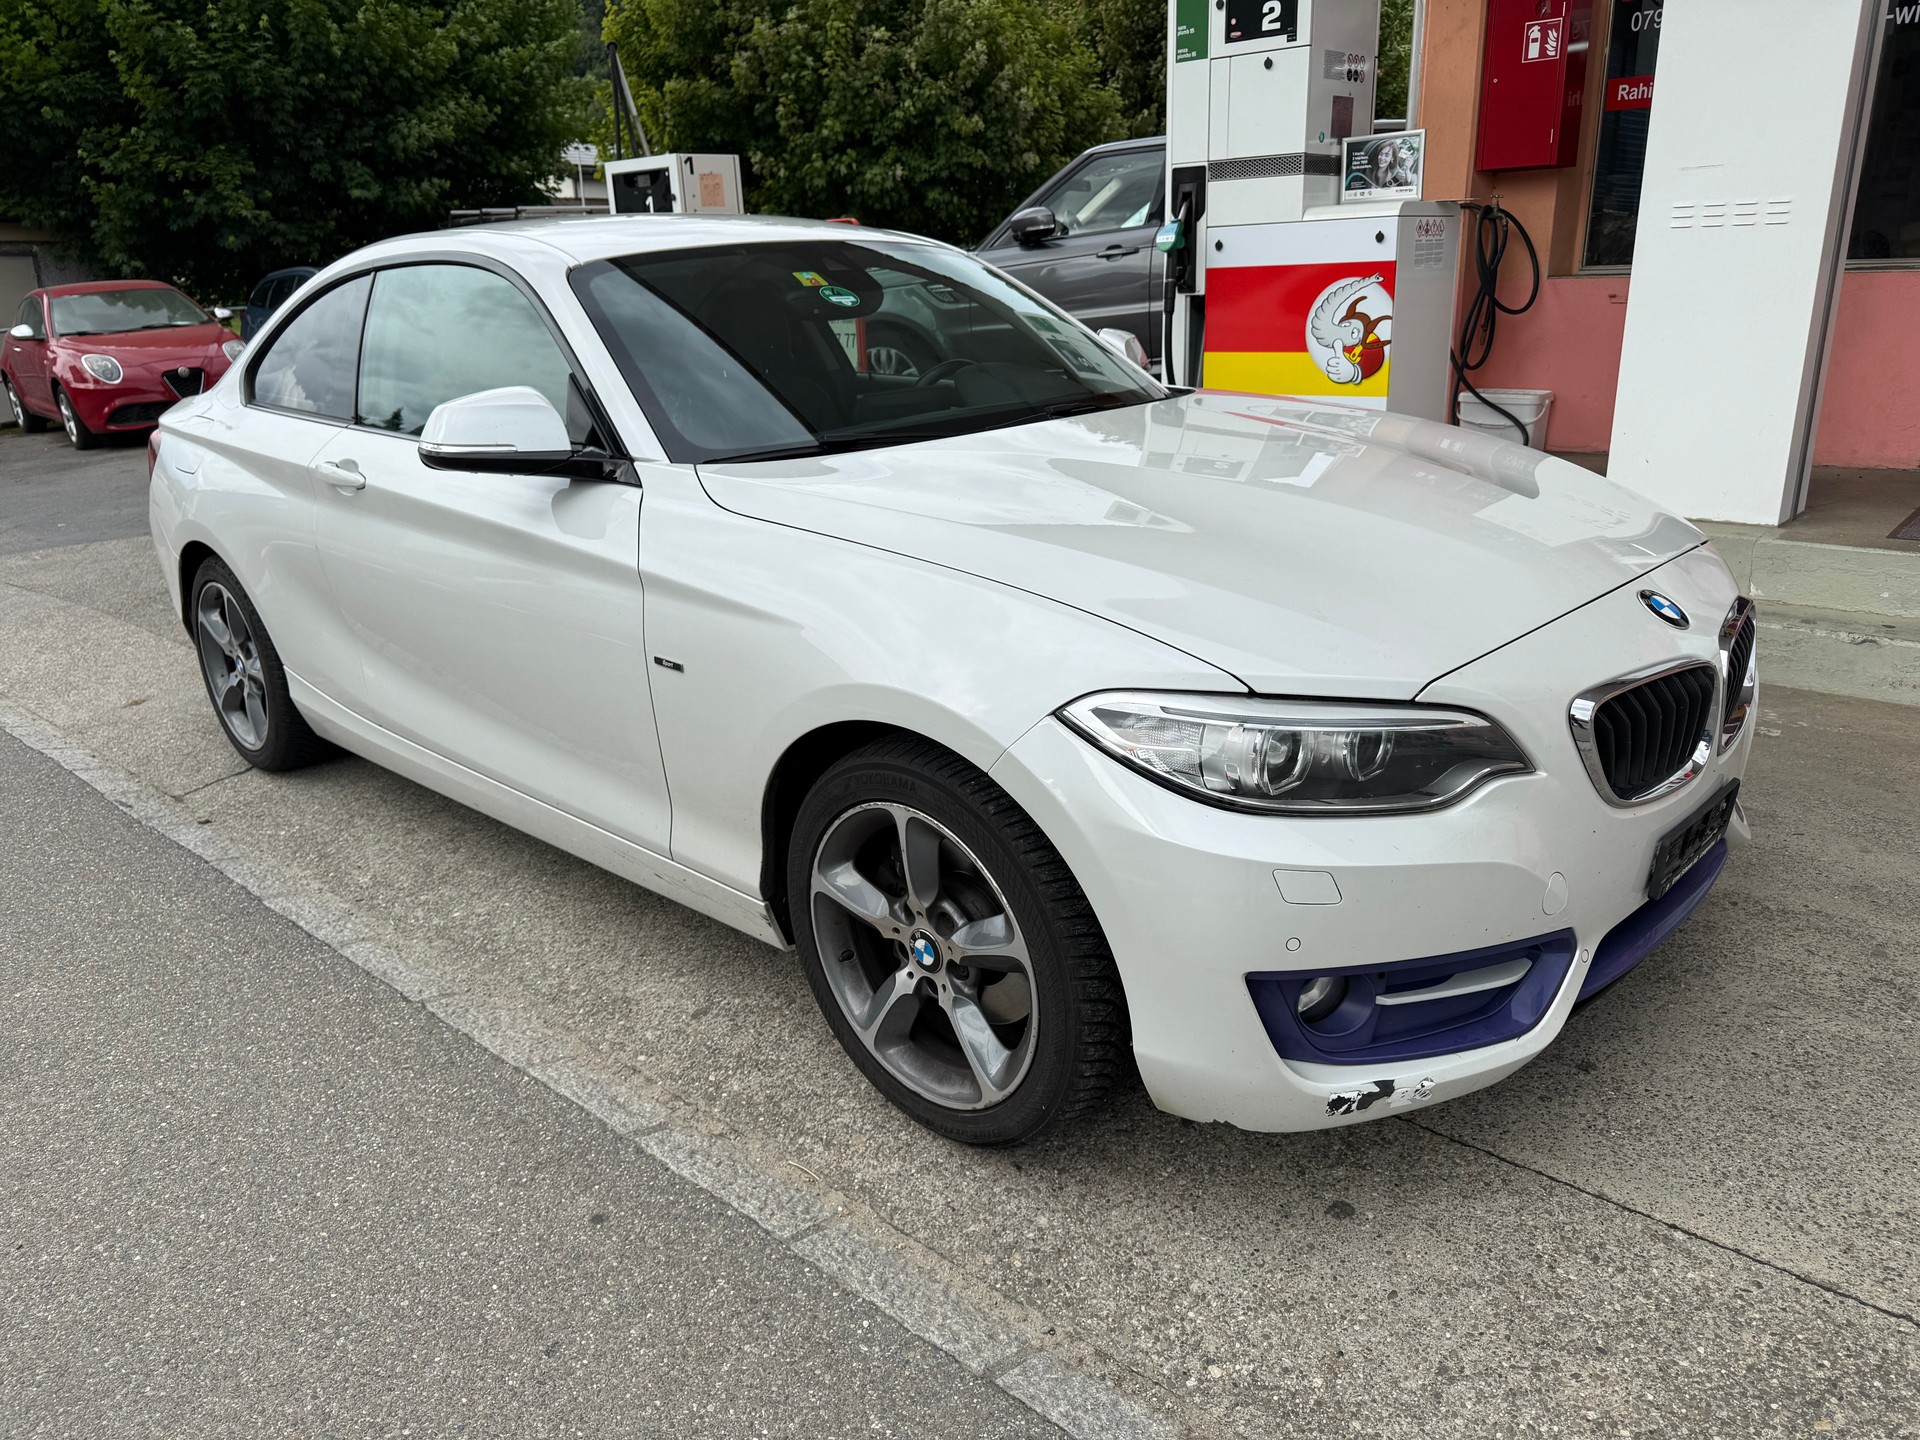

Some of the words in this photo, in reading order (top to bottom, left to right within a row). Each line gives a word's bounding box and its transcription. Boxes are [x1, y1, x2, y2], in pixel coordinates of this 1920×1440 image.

[1262, 0, 1281, 31] 2
[1631, 9, 1664, 31] 079
[1618, 82, 1654, 101] Rahi
[684, 156, 694, 175] 1
[645, 195, 654, 213] 1
[854, 772, 918, 794] YOKOHAMA
